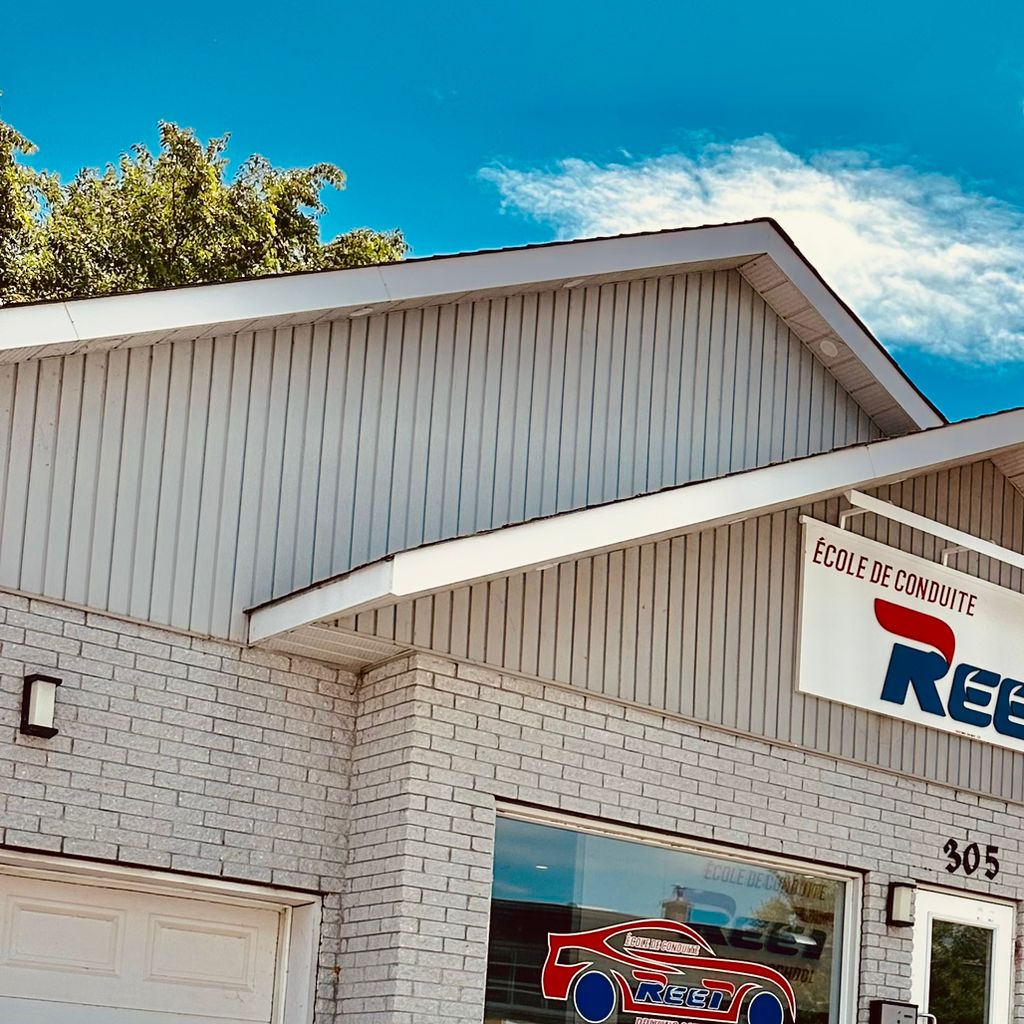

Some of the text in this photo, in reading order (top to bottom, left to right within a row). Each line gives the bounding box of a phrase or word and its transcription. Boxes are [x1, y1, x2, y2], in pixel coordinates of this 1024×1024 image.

[812, 536, 978, 617] ÉCOLE DE CONDUITE
[943, 838, 1000, 880] 305
[631, 969, 736, 1010] REET
